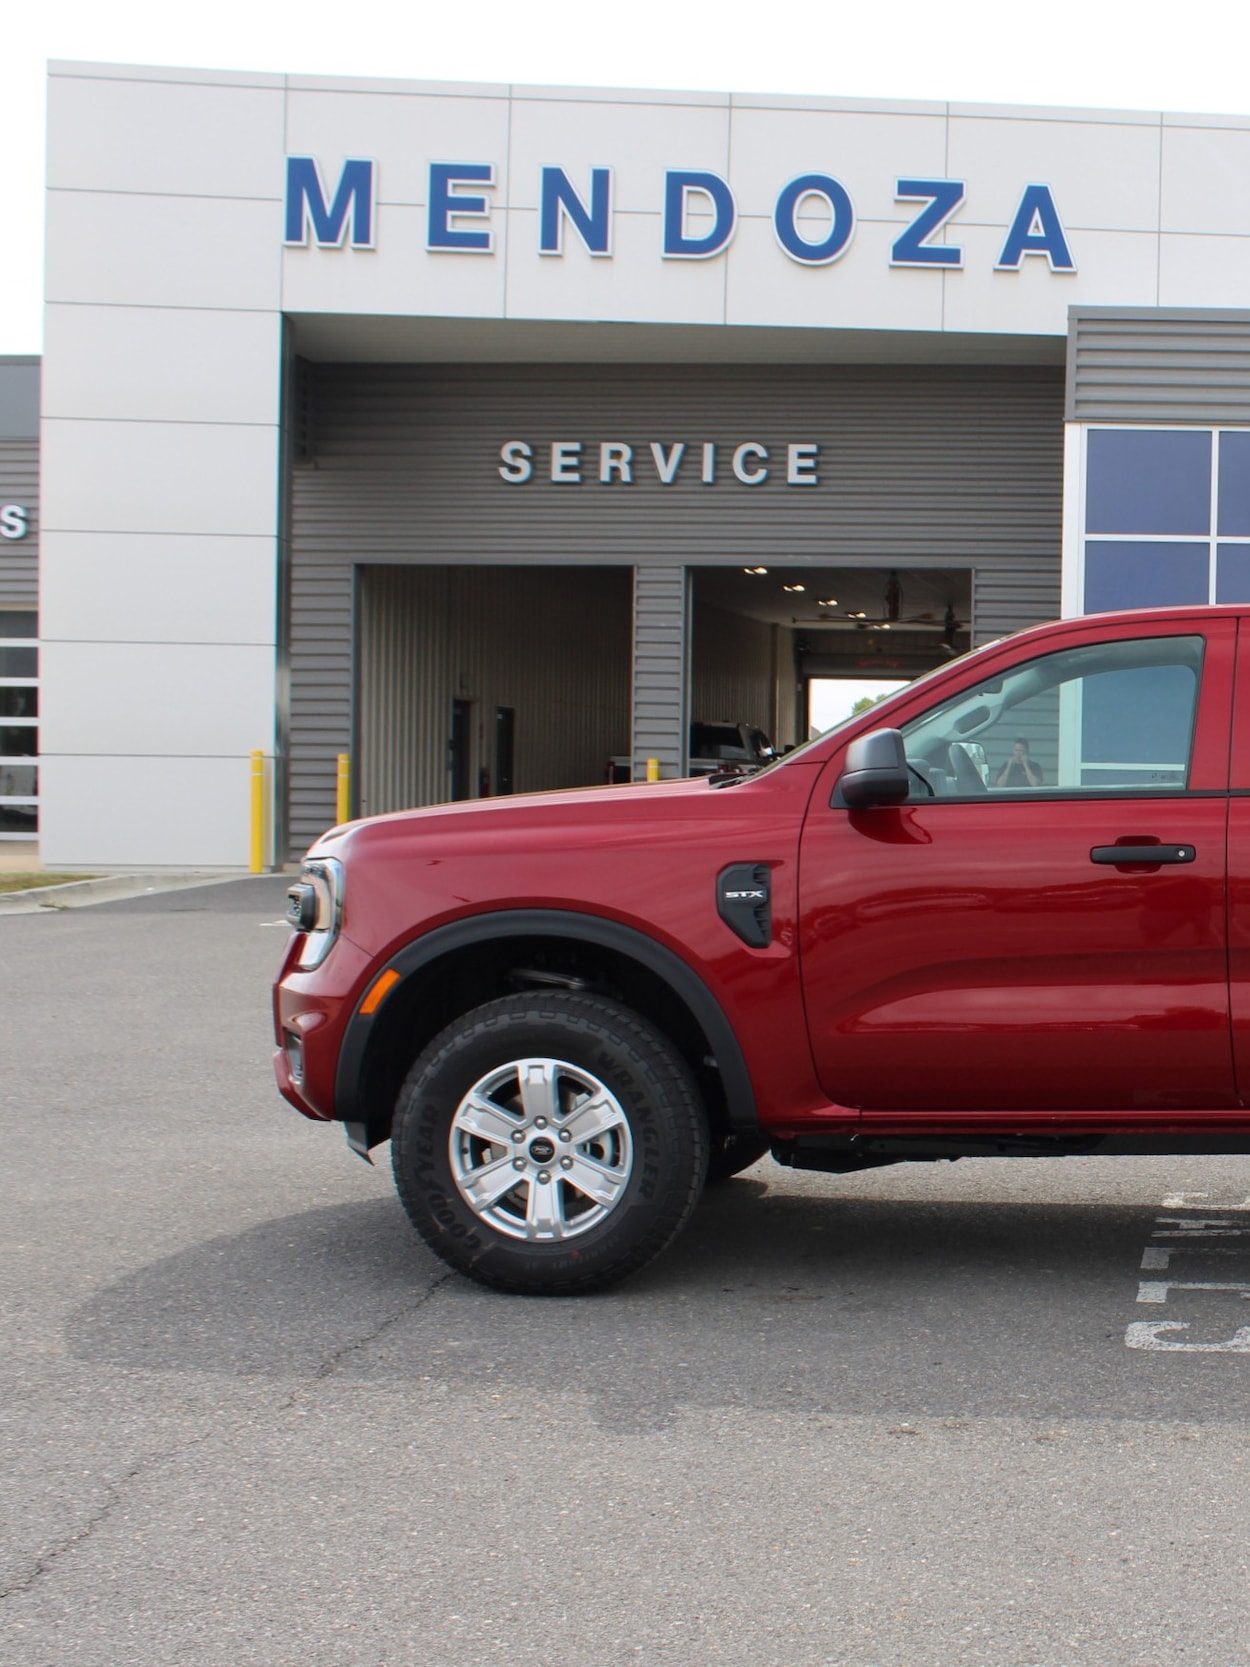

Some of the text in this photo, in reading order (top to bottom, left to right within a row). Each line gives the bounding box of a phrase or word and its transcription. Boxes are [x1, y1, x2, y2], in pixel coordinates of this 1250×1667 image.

[283, 154, 1077, 274] MENDOZA
[499, 440, 819, 485] SERVICE
[725, 890, 764, 898] STX
[414, 1103, 482, 1249] GOODYEAR
[598, 1051, 660, 1199] WRANGLER
